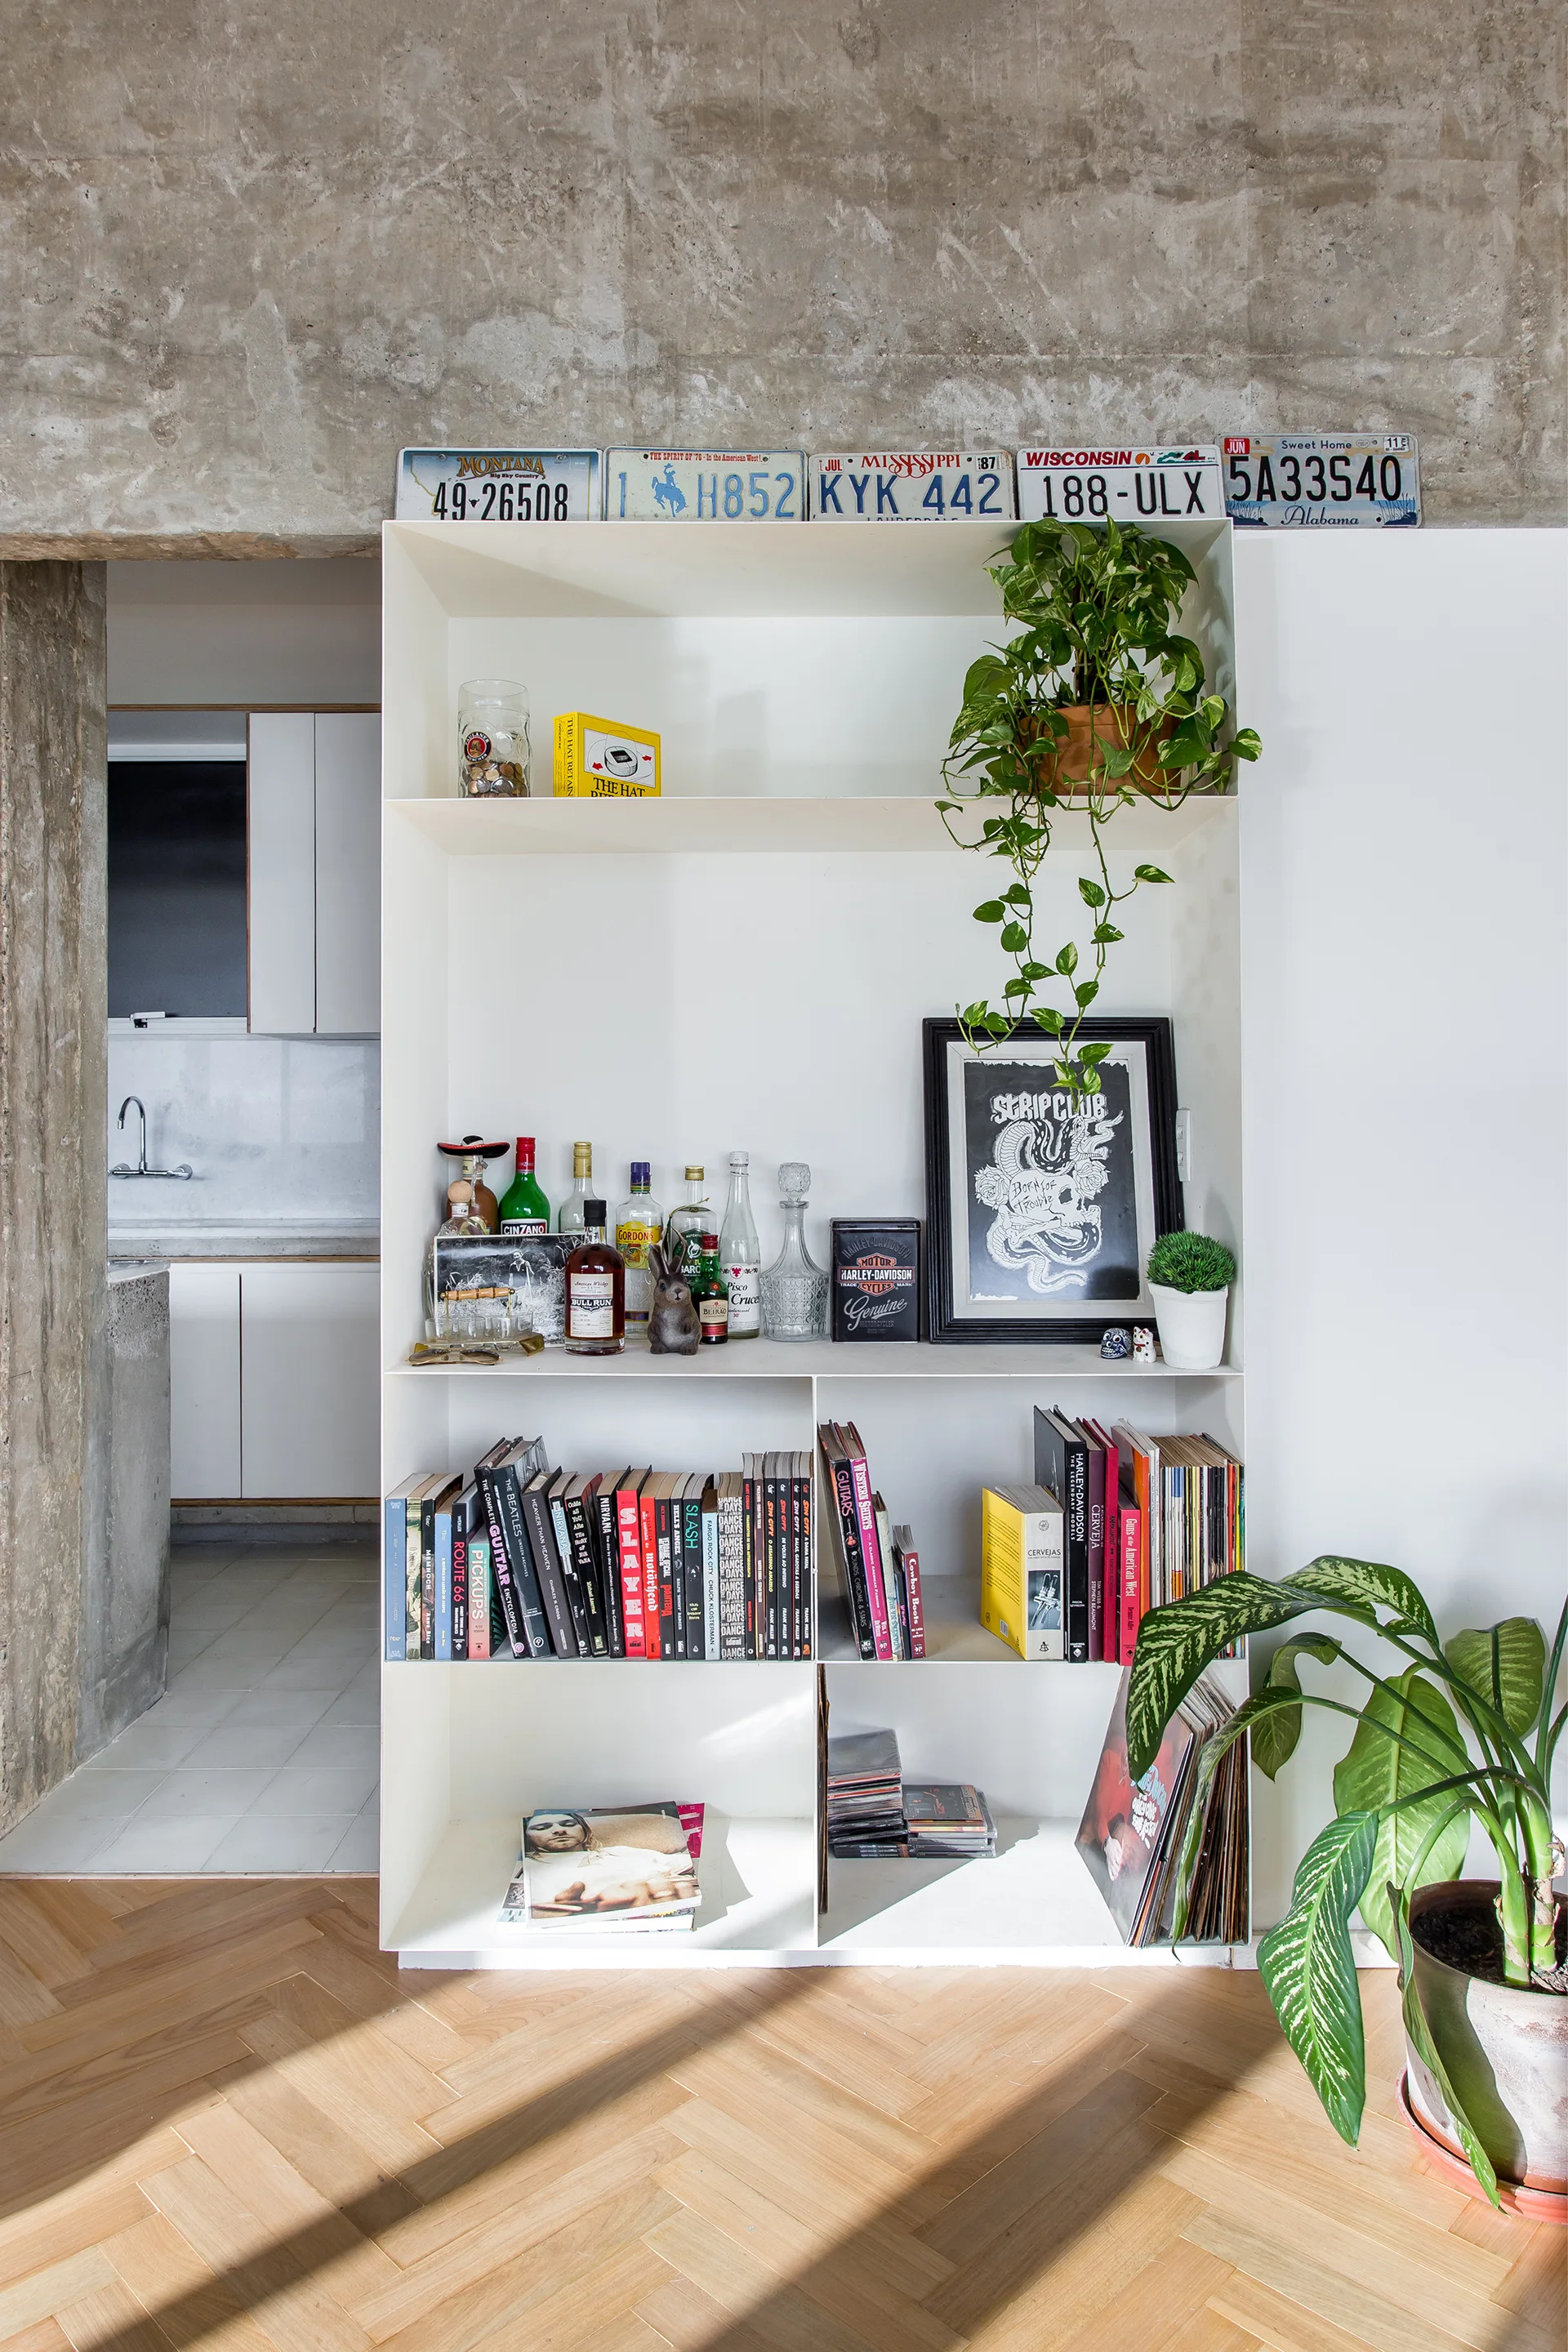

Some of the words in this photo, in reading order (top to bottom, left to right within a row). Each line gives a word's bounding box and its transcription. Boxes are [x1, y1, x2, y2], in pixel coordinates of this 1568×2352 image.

[1227, 442, 1245, 454] JUN
[1281, 440, 1316, 449] Sweet
[1321, 440, 1352, 449] Home
[650, 452, 662, 461] THE
[663, 452, 684, 461] SPIRIT
[713, 453, 721, 461] the
[722, 454, 746, 462] American
[825, 459, 843, 471] JUL
[1026, 451, 1133, 466] WISCONSIN
[457, 457, 545, 478] MONTANA
[861, 454, 960, 479] MISSISSIPPI
[697, 473, 795, 519] H852
[819, 474, 900, 514] KYK
[922, 474, 1003, 515] 442
[1281, 504, 1360, 526] Alabama
[593, 777, 619, 795] THE
[620, 783, 646, 797] HAT
[503, 1224, 545, 1235] CINZANO
[618, 1229, 654, 1241] GORDON'S
[841, 1236, 912, 1260] HARLEY-DAVIDSON
[862, 1255, 892, 1267] MOTOR
[840, 1269, 913, 1281] HARLEY-DAVIDSON
[727, 1281, 748, 1291] Pisco
[862, 1282, 892, 1294] CYCLES
[593, 1298, 612, 1307] RUN
[844, 1295, 908, 1331] Genuine
[505, 1479, 513, 1493] THE
[853, 1462, 869, 1501] WESTERN
[1076, 1453, 1085, 1542] HARLEY-DAVIDSON
[483, 1493, 496, 1525] COMPLETE
[506, 1494, 523, 1537] BEATLES
[600, 1497, 612, 1534] NIRVANA
[724, 1503, 742, 1512] DAYS
[858, 1501, 873, 1530] SHIRTS
[685, 1504, 699, 1549] SLASH
[718, 1515, 743, 1525] DANCE
[1089, 1504, 1101, 1549] CERVEJA
[1125, 1518, 1137, 1535] Guns
[532, 1499, 541, 1526] HEAVIER
[541, 1544, 551, 1570] HEAVEN
[555, 1511, 568, 1551] NIRVANA
[725, 1525, 743, 1534] DAYS
[719, 1537, 743, 1547] DANCE
[836, 1469, 854, 1517] GUITARS
[859, 1610, 867, 1628] STARS
[489, 1525, 510, 1586] GUITAR
[725, 1547, 743, 1556] DAYS
[1027, 1548, 1062, 1557] CERVEJAS
[454, 1541, 465, 1583] ROUTE
[521, 1556, 529, 1578] ARCHIVES
[719, 1559, 744, 1569] DANCE
[782, 1559, 787, 1567] AO
[1125, 1547, 1137, 1579] American
[619, 1507, 644, 1637] SLAYER
[726, 1569, 744, 1578] DAYS
[909, 1557, 918, 1596] Cowboy
[470, 1549, 483, 1620] PICKUPS
[645, 1552, 658, 1612] motörhead
[720, 1581, 744, 1591] DANCE
[1125, 1580, 1137, 1597] West
[454, 1585, 465, 1602] 66
[661, 1584, 673, 1617] PANTERA
[726, 1591, 745, 1600] DAYS
[503, 1588, 519, 1634] ENCYCLOPEDIA
[721, 1604, 745, 1613] DANCE
[911, 1597, 920, 1624] Boots
[727, 1613, 745, 1622] DAYS
[721, 1625, 745, 1636] DANCE
[722, 1647, 746, 1658] DANCE
